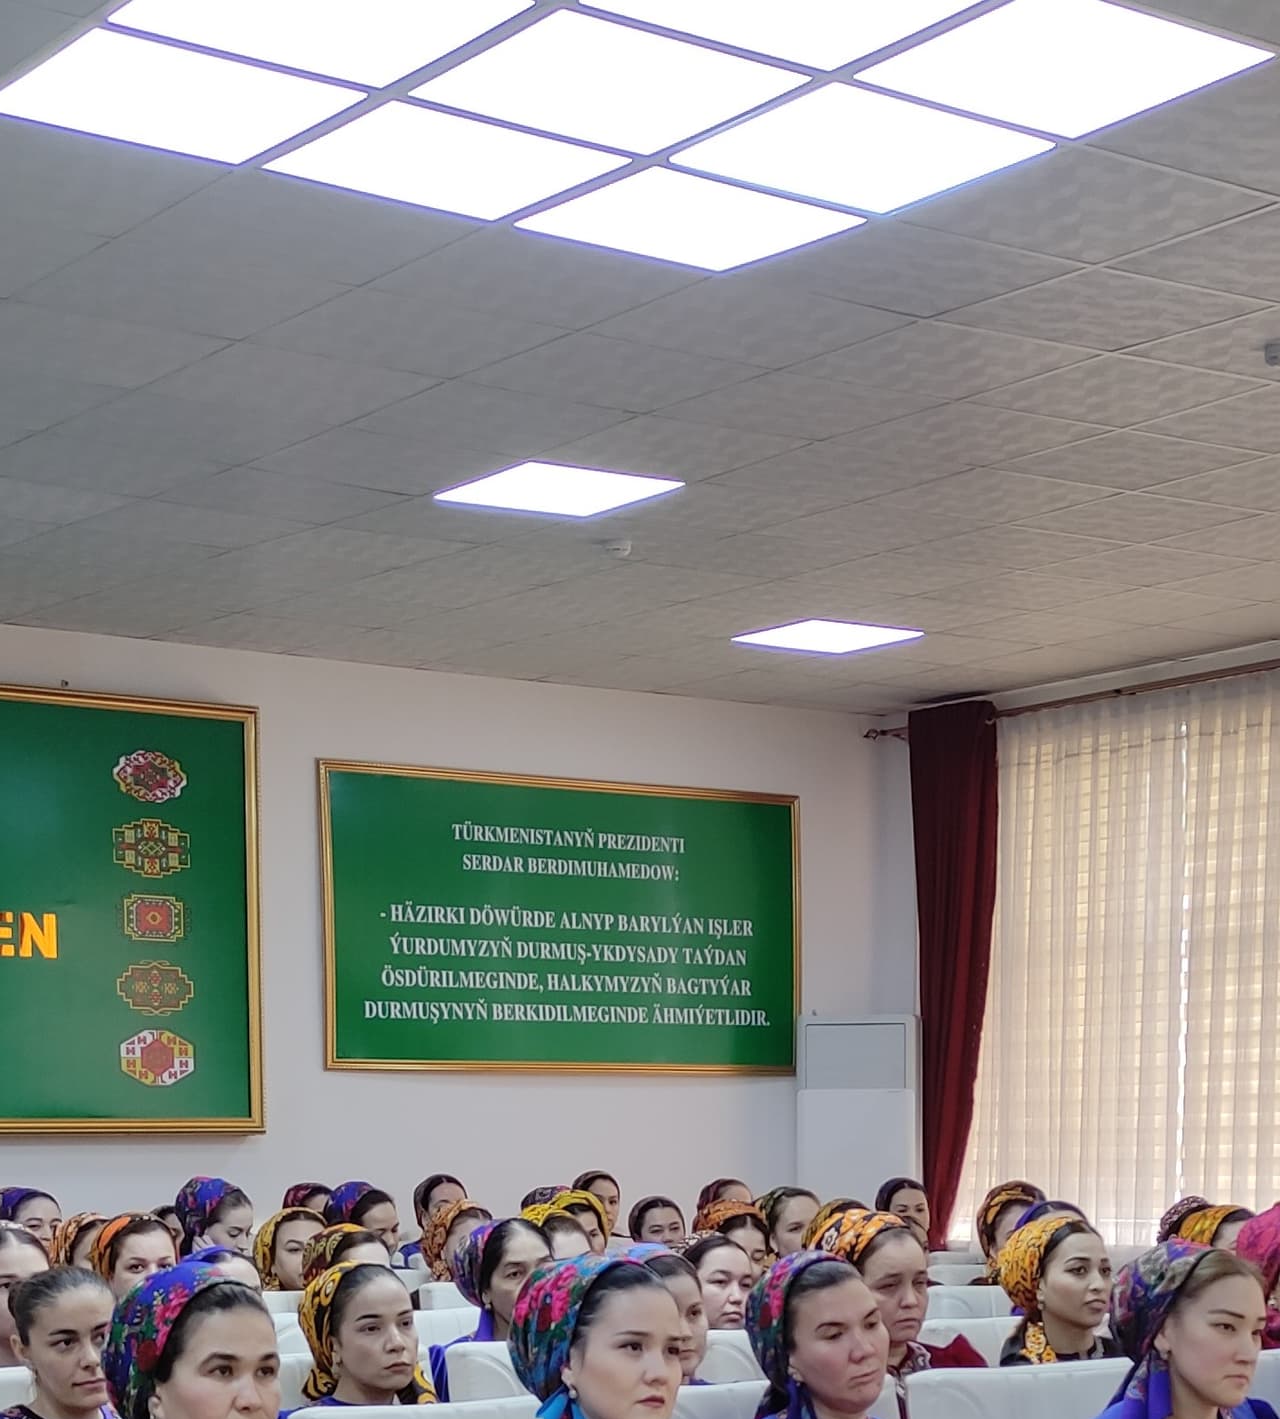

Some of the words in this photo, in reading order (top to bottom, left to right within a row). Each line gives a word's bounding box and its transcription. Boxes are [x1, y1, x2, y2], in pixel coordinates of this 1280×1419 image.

[452, 820, 594, 848] TÜRKMENISTANYŇ
[598, 833, 685, 853] PREZIDENTI
[462, 854, 524, 873] SERDAR
[528, 857, 679, 881] BERDIMUHAMEDOW:
[390, 901, 465, 925] HÄZIRKI
[470, 904, 556, 929] DÖWÜRDE
[560, 912, 614, 931] ALNYP
[618, 912, 705, 935] BARYLÝAN
[708, 918, 754, 940] IŞLER
[390, 932, 512, 958] ÝURDUMYZYŇ
[517, 941, 679, 965] DURMUŞ-YKDYSADY
[682, 944, 747, 966] TAÝDAN
[381, 965, 544, 993] ÖSDÜRILMEGINDE,
[547, 972, 662, 993] HALKYMYZYŇ
[667, 974, 752, 996] BAGTYÝAR
[364, 998, 488, 1024] DURMUŞYNYŇ
[492, 1002, 649, 1024] BERKIDILMEGINDE
[652, 1003, 770, 1027] ÄHMIÝETLIDIR.
